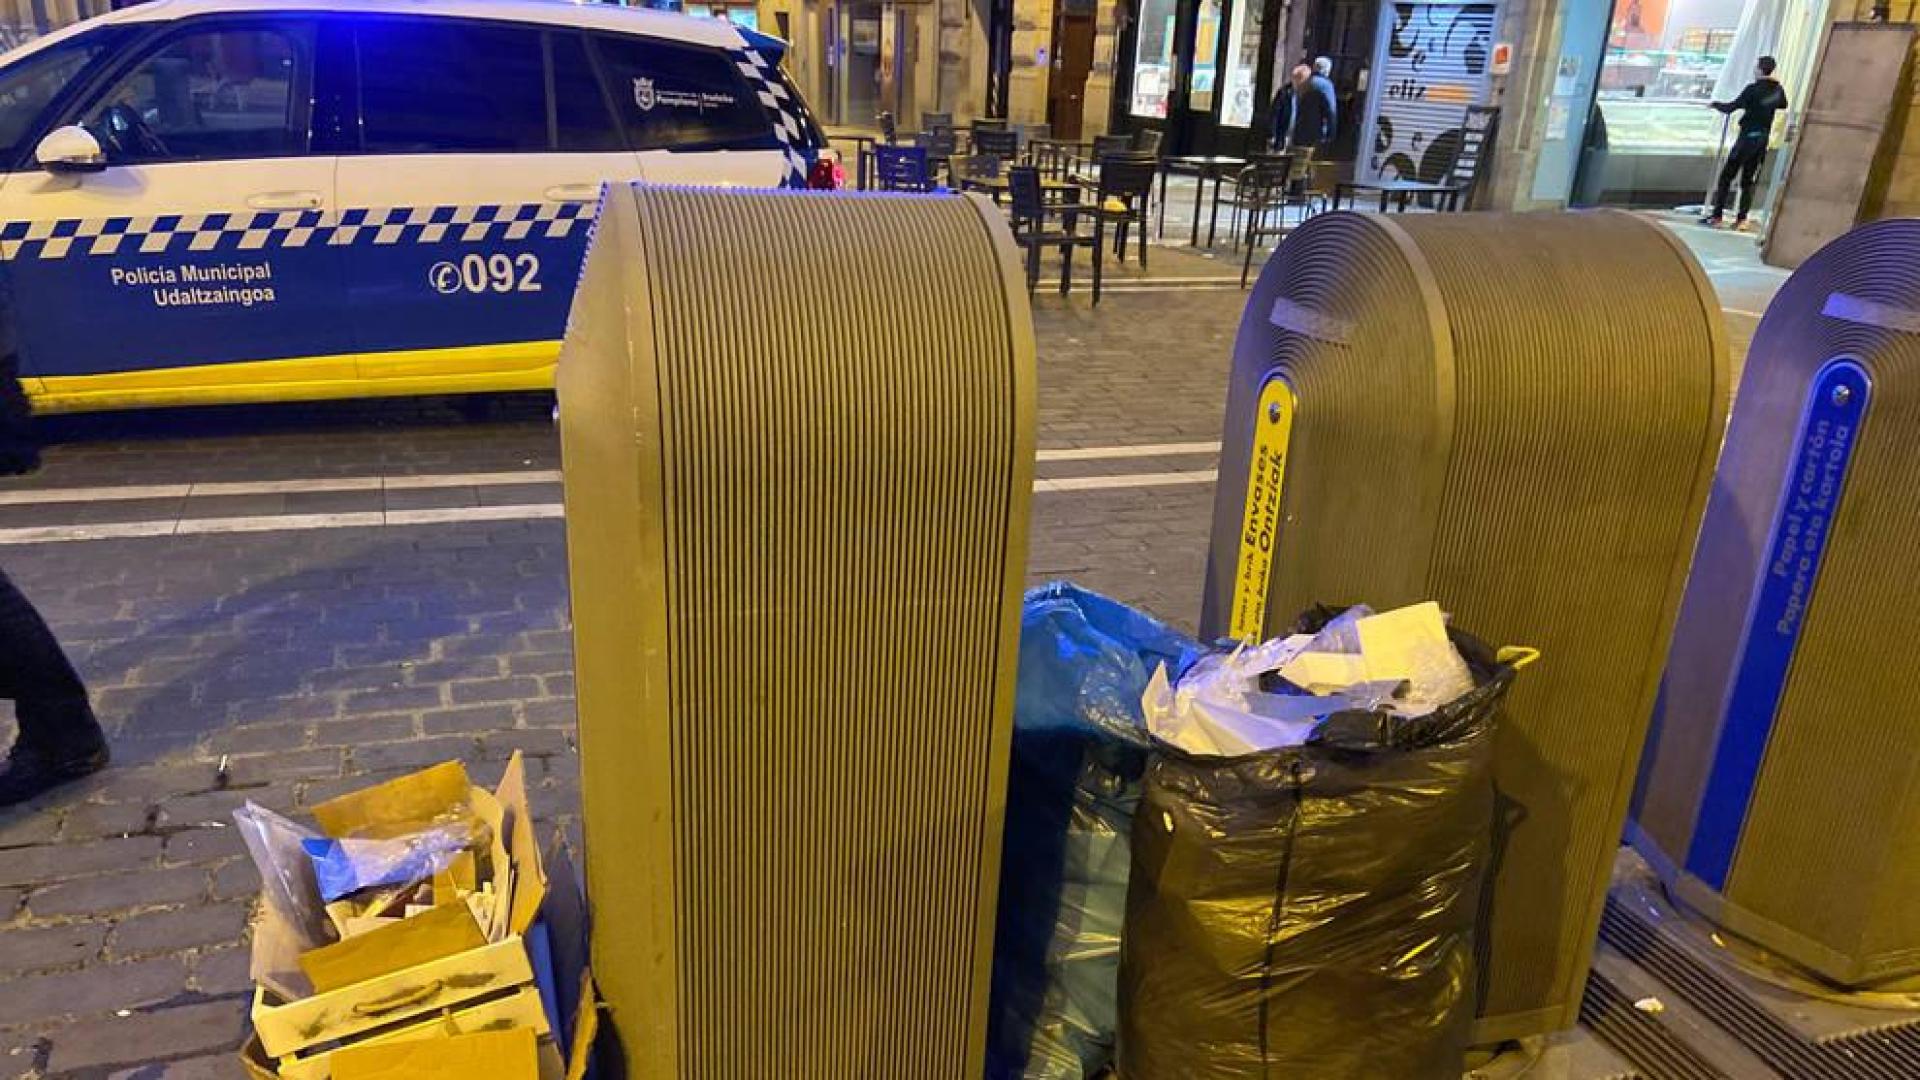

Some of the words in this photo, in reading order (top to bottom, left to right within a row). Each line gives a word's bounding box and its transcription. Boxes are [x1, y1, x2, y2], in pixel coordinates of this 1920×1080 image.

[153, 285, 275, 307] Udaltzaingoa
[181, 262, 271, 284] Municipal
[462, 254, 542, 293] 092
[1245, 445, 1268, 547] Envases
[1258, 451, 1282, 553] Ontziak
[1772, 510, 1804, 578] Papel
[1776, 556, 1811, 635] Papera
